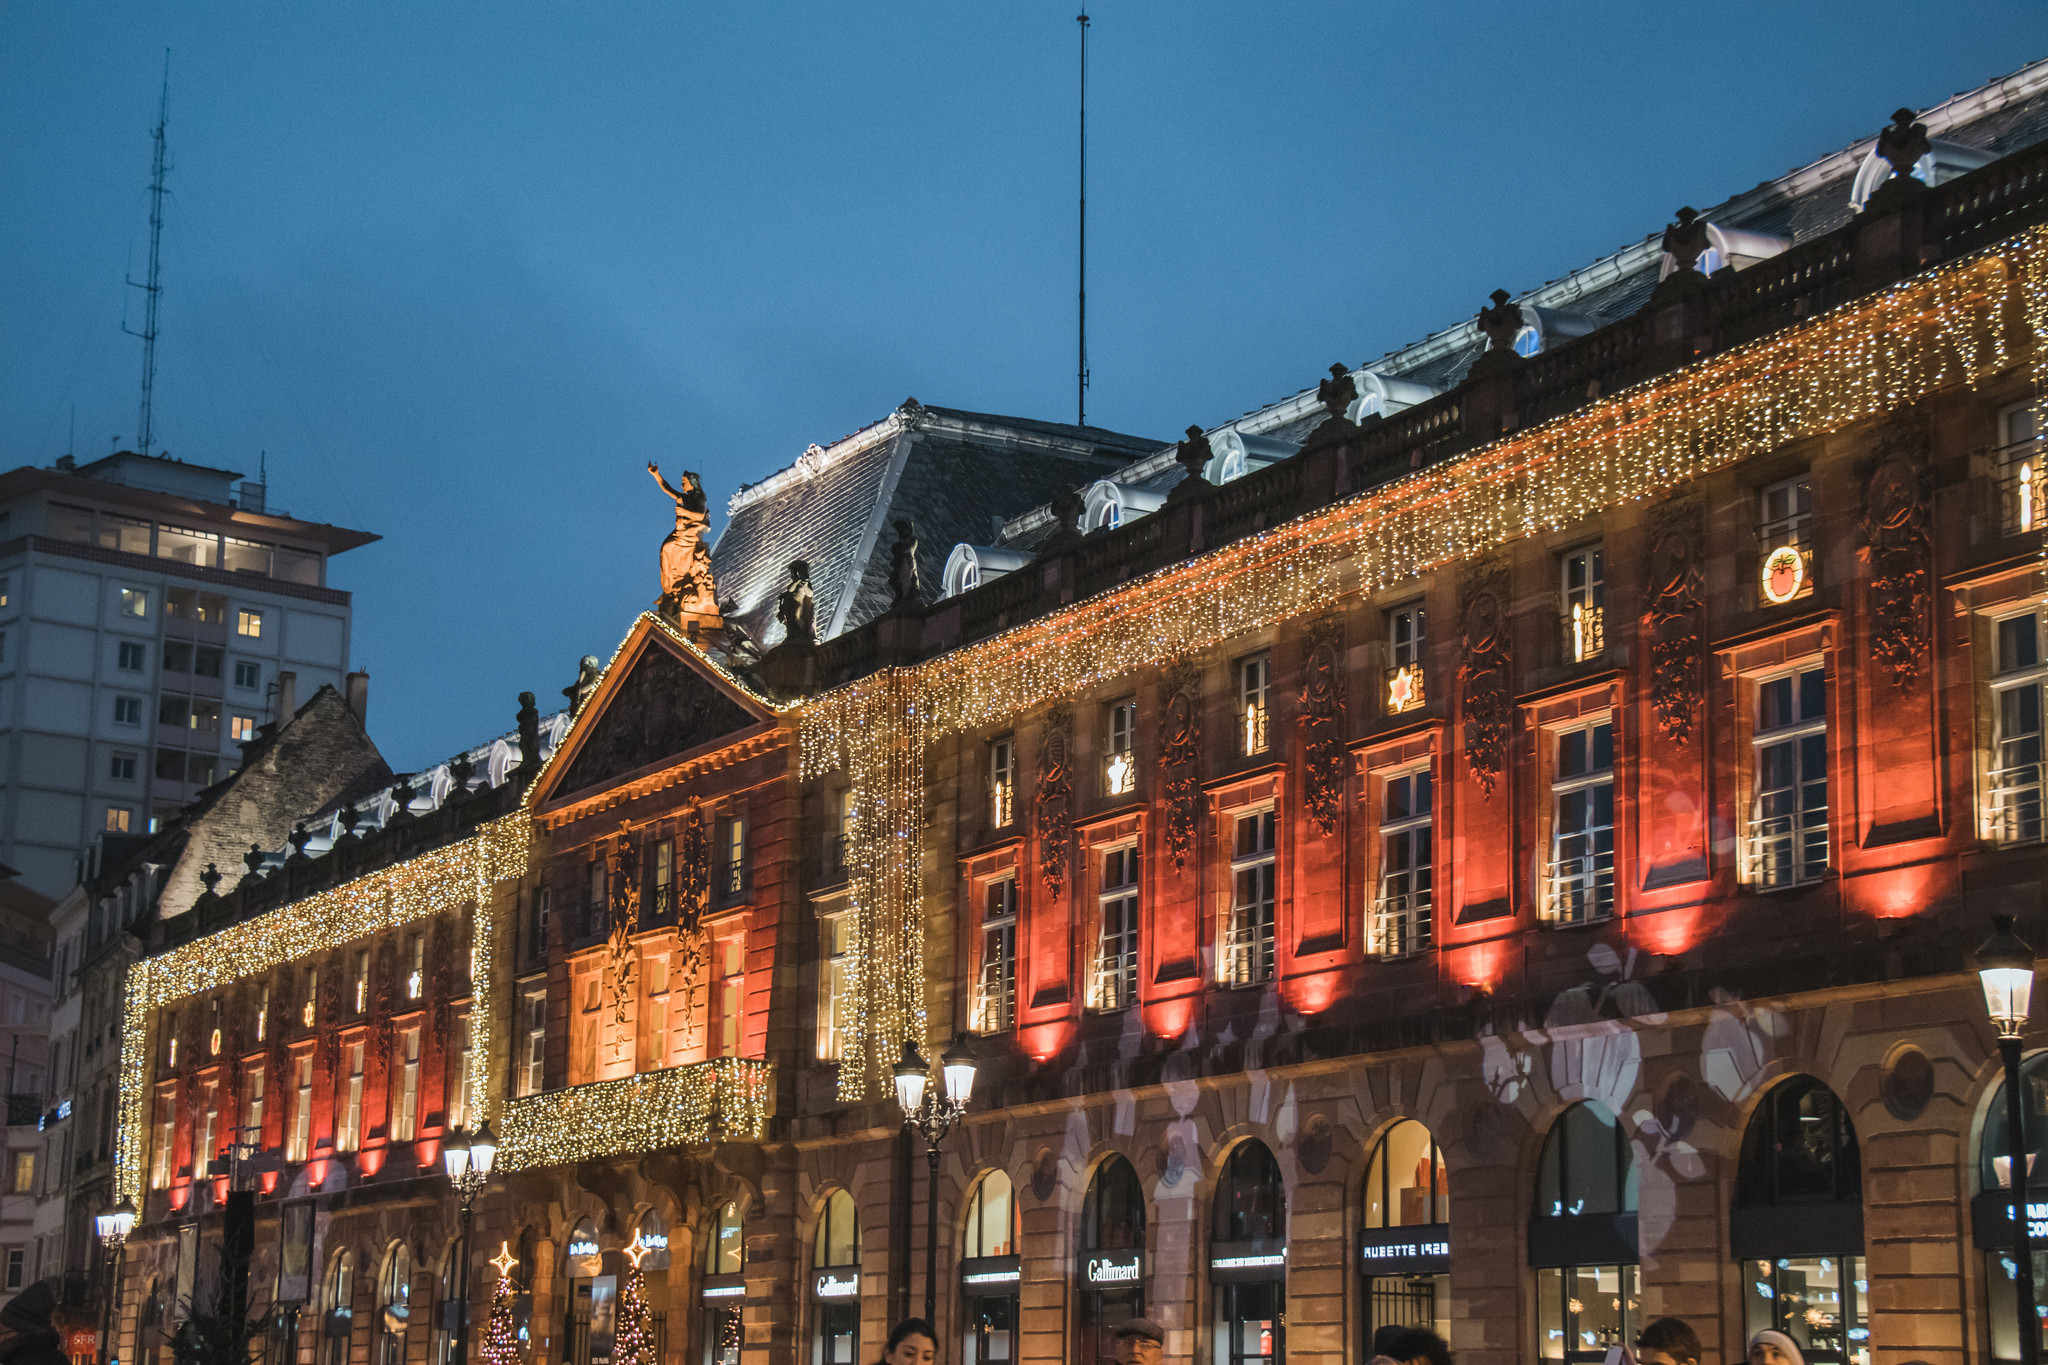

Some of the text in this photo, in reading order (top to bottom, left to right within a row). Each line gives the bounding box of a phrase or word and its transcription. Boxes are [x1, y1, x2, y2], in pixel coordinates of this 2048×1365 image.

[1364, 1244, 1417, 1258] AUBETTE
[1088, 1256, 1139, 1281] Gallimard
[73, 1335, 95, 1345] SFR
